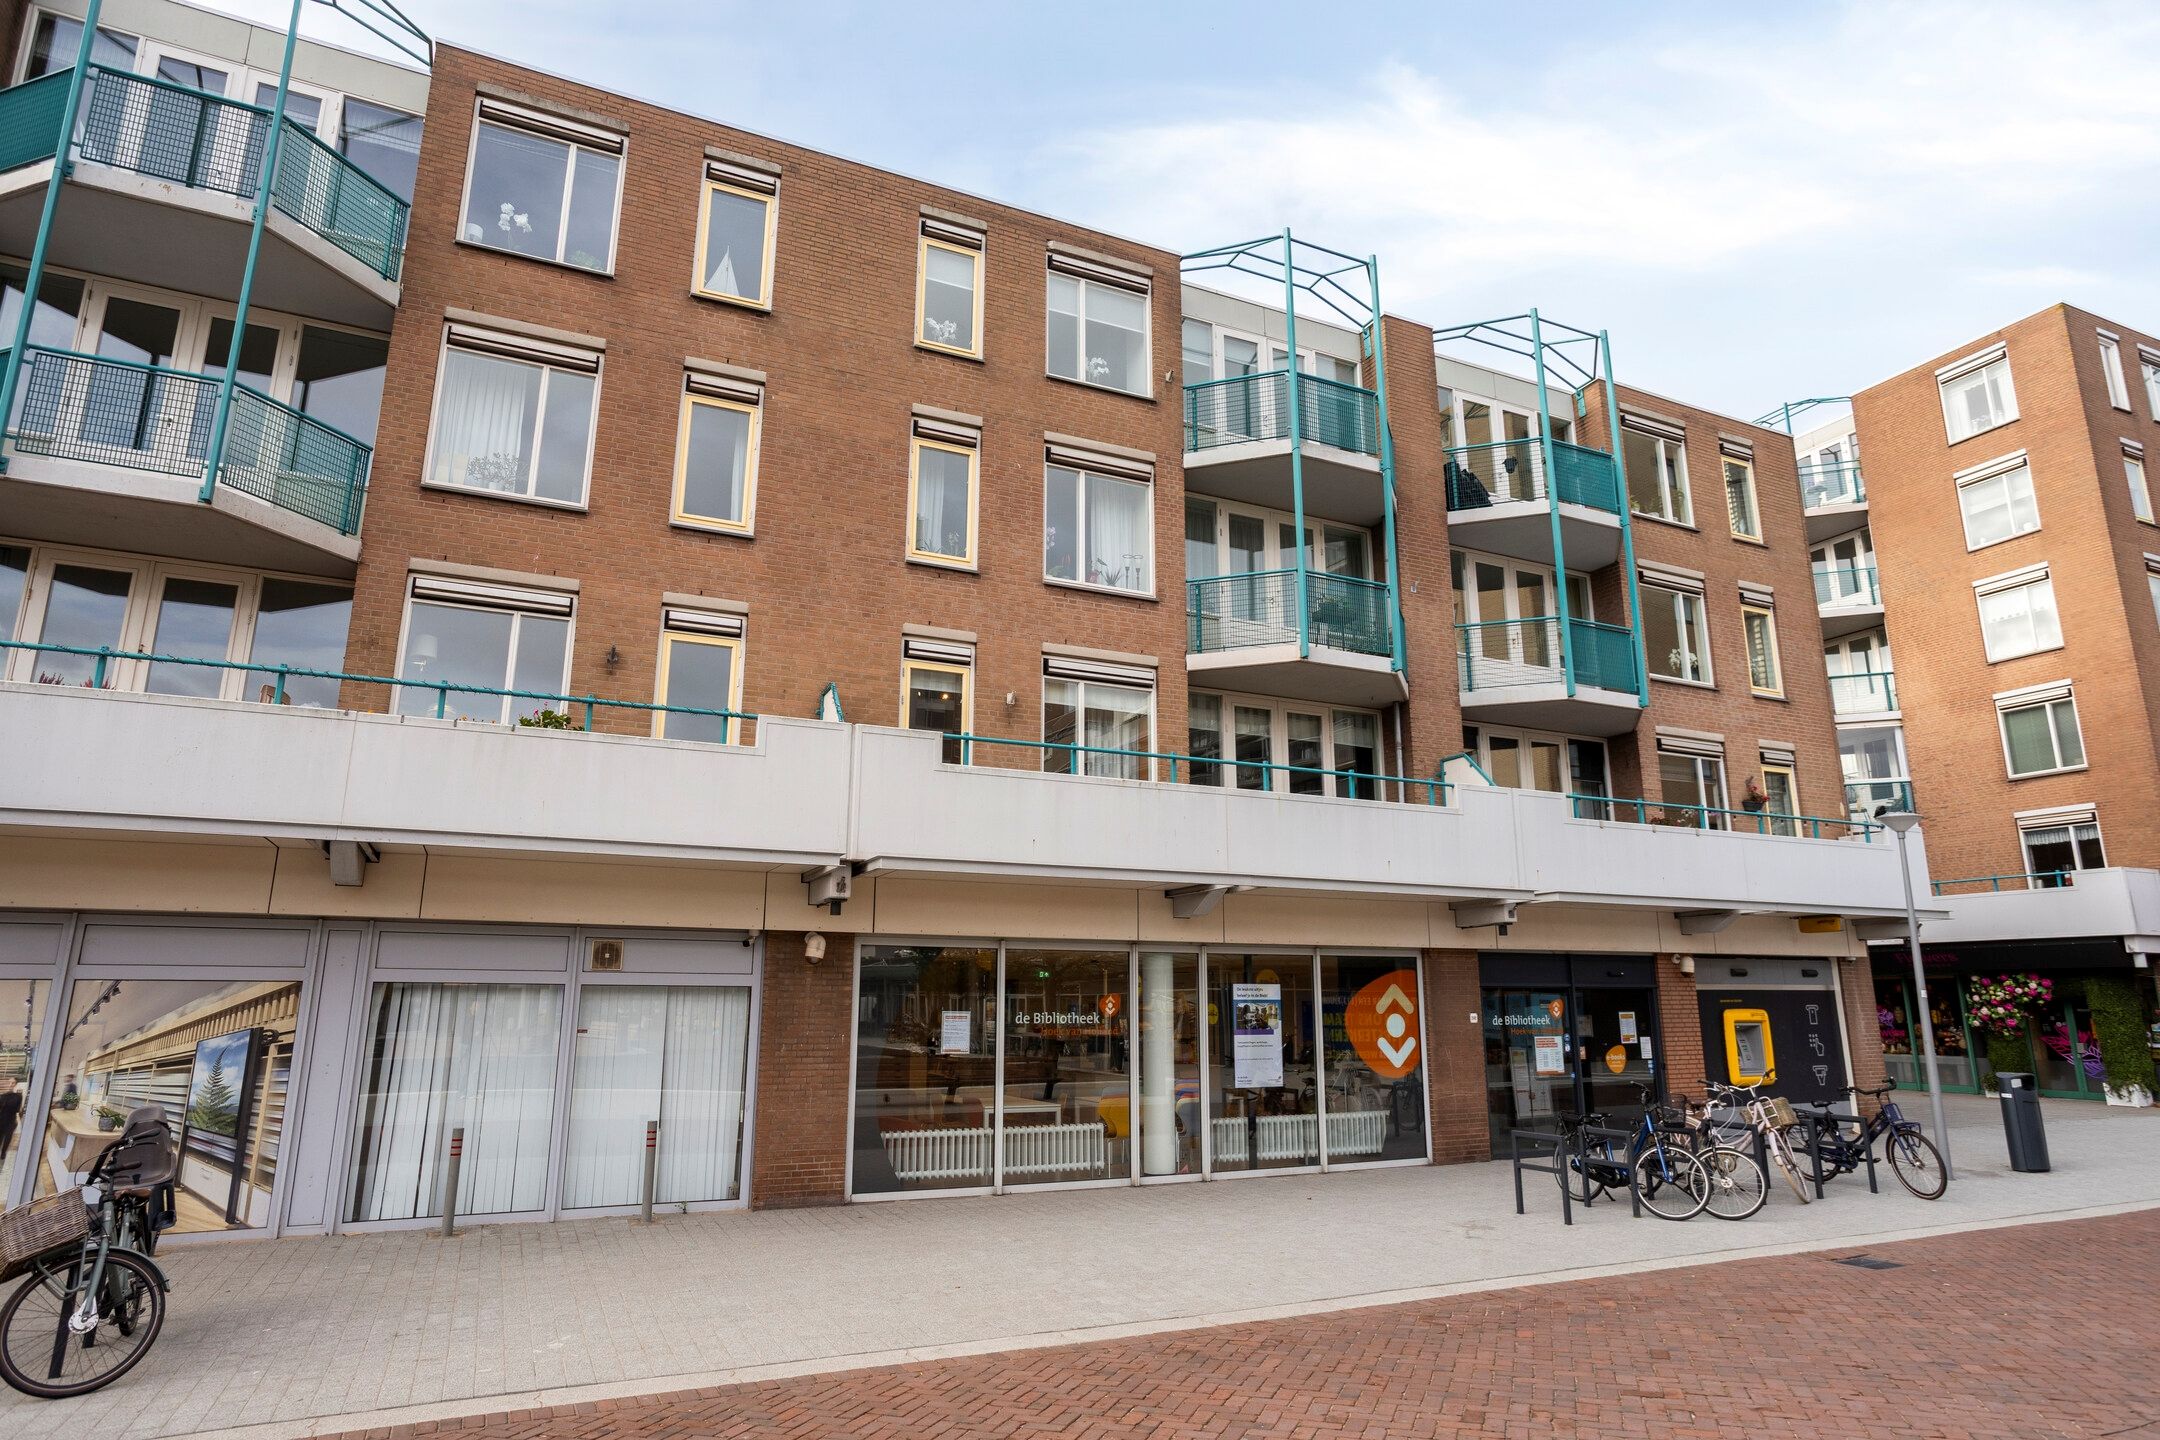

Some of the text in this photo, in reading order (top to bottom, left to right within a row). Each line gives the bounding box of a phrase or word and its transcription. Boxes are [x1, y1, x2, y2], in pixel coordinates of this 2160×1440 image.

[1015, 1011, 1100, 1024] de Bibliotheek
[1492, 1014, 1551, 1025] de Bibliotheek
[1511, 1027, 1526, 1035] Hoek
